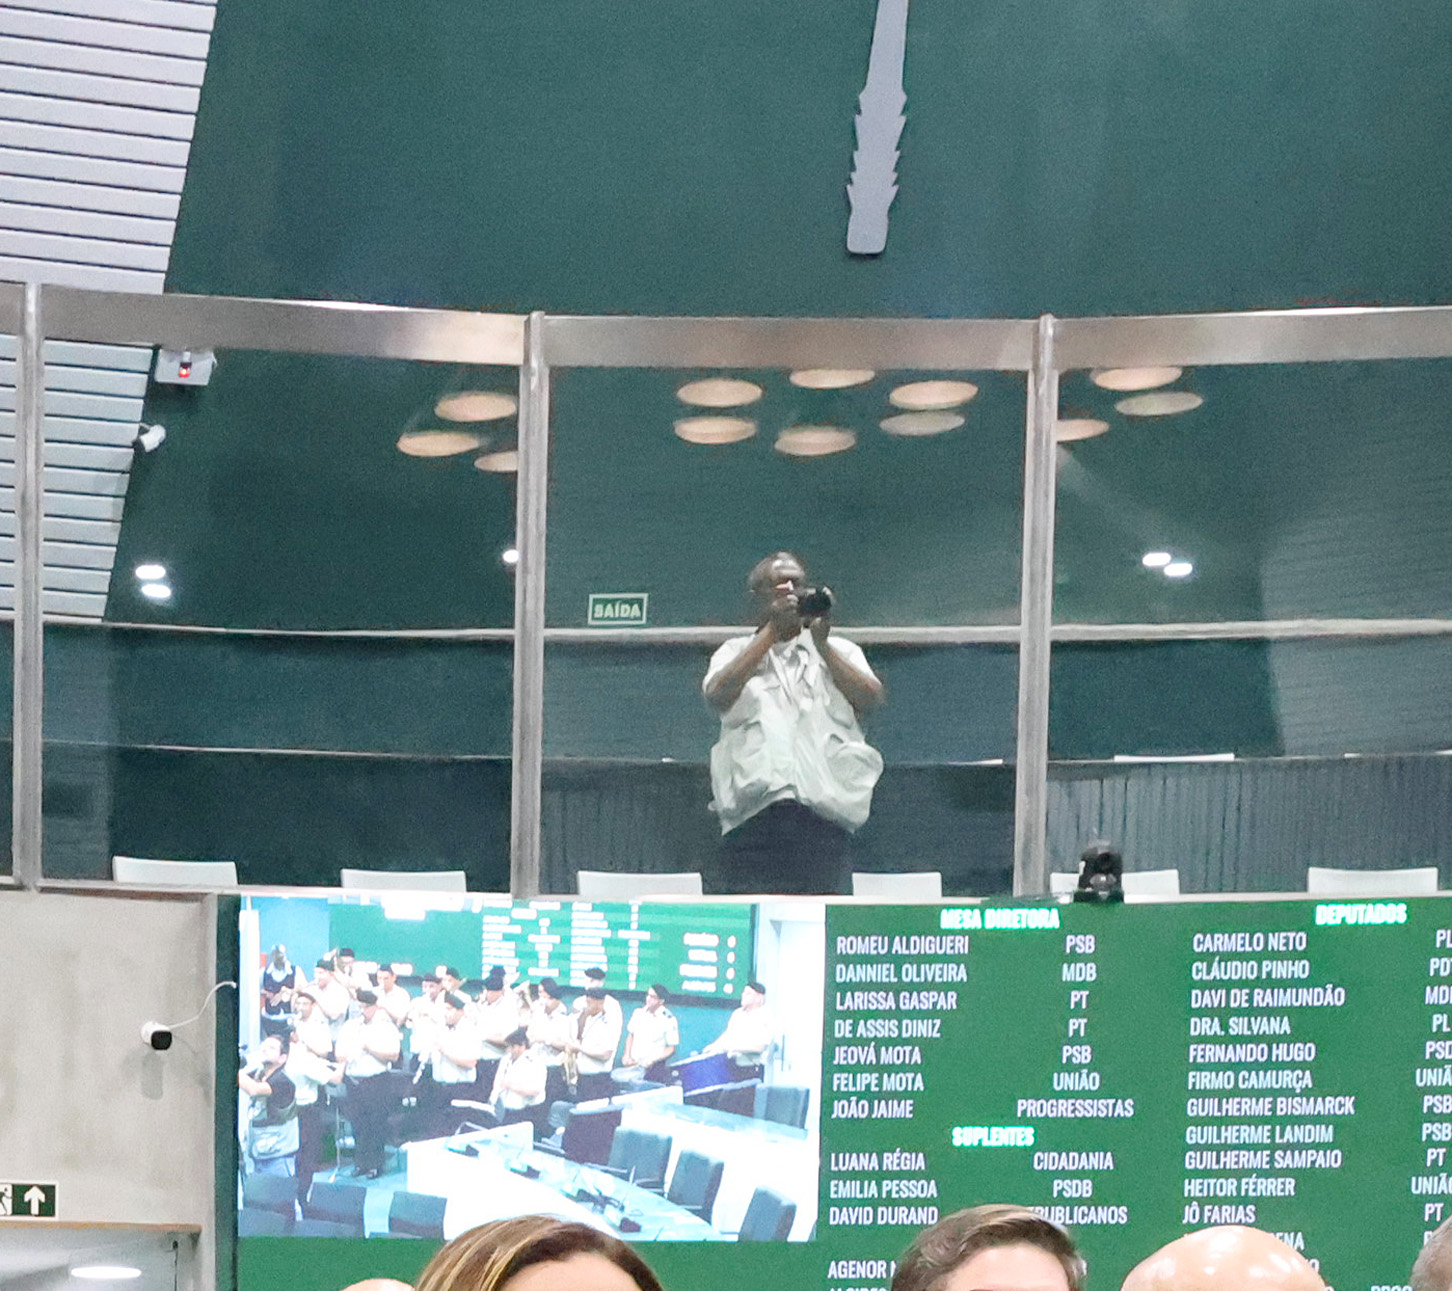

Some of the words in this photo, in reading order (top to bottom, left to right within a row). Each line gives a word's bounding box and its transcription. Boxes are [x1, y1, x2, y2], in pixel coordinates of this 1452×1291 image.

[594, 601, 641, 618] SAÍDA
[941, 909, 982, 929] MESA
[985, 909, 1059, 928] DIRETORA
[1316, 904, 1407, 925] DEPUTADOS
[837, 936, 888, 954] ROMEU
[892, 935, 969, 954] ALDIGUERI
[1066, 935, 1095, 953] PSB
[1193, 933, 1264, 952] CARMELO
[1268, 932, 1306, 951] NETO
[836, 964, 897, 982] DANNIEL
[902, 964, 967, 982] OLIVEIRA
[1062, 963, 1096, 981] MDB
[1192, 956, 1258, 980] CLÁUDIO
[1262, 960, 1309, 978] PINHO
[836, 991, 896, 1010] LARISSA
[899, 991, 957, 1010] GASPAR
[1071, 991, 1089, 1009] PT
[1191, 989, 1226, 1008] DAVI
[1230, 988, 1250, 1007] DE
[1253, 984, 1345, 1007] RAIMUNDÃO
[835, 1019, 853, 1038] DE
[857, 1019, 898, 1038] ASSIS
[902, 1019, 941, 1037] DINIZ
[1069, 1018, 1087, 1037] PT
[1190, 1017, 1224, 1036] DRA.
[1229, 1016, 1290, 1035] SILVANA
[1433, 1014, 1450, 1032] PL
[833, 1042, 876, 1064] JEOVÁ
[880, 1046, 921, 1064] MOTA
[1062, 1045, 1091, 1064] PSB
[1189, 1044, 1268, 1062] FERNANDO
[1272, 1043, 1315, 1061] HUGO
[833, 1073, 879, 1091] FELIPE
[883, 1073, 924, 1091] MOTA
[1054, 1069, 1100, 1090] UNIÃO
[1188, 1071, 1234, 1089] FIRMO
[1239, 1070, 1312, 1093] CAMURÇA
[832, 1097, 869, 1118] JOÃO
[872, 1100, 913, 1118] JAIME
[1017, 1099, 1134, 1117] PROGRESSISTAS
[1187, 1097, 1273, 1116] GUILHERME
[1277, 1096, 1355, 1115] BISMARCK
[1423, 1095, 1452, 1113] PSB
[952, 1127, 1034, 1146] SUPLENTES
[1186, 1125, 1271, 1144] GUILHERME
[1275, 1125, 1333, 1143] LANDIM
[1422, 1123, 1452, 1141] PSB
[831, 1153, 879, 1171] LUANA
[883, 1148, 925, 1170] RÉGIA
[1034, 1152, 1113, 1170] CIDADANIA
[1185, 1150, 1270, 1169] GUILHERME
[1274, 1150, 1341, 1168] SAMPAIO
[1427, 1148, 1446, 1166] PT
[830, 1180, 877, 1198] EMILIA
[882, 1180, 937, 1198] PESSOA
[1053, 1179, 1092, 1197] PSDB
[1184, 1178, 1237, 1197] HEITOR
[1241, 1173, 1295, 1196] FÉRRER
[830, 1207, 873, 1225] DAVID
[877, 1206, 938, 1225] DURAND
[1183, 1201, 1200, 1224] JÔ
[1204, 1205, 1255, 1224] FARIAS
[1425, 1203, 1444, 1221] PT
[828, 1260, 886, 1279] AGENOR
